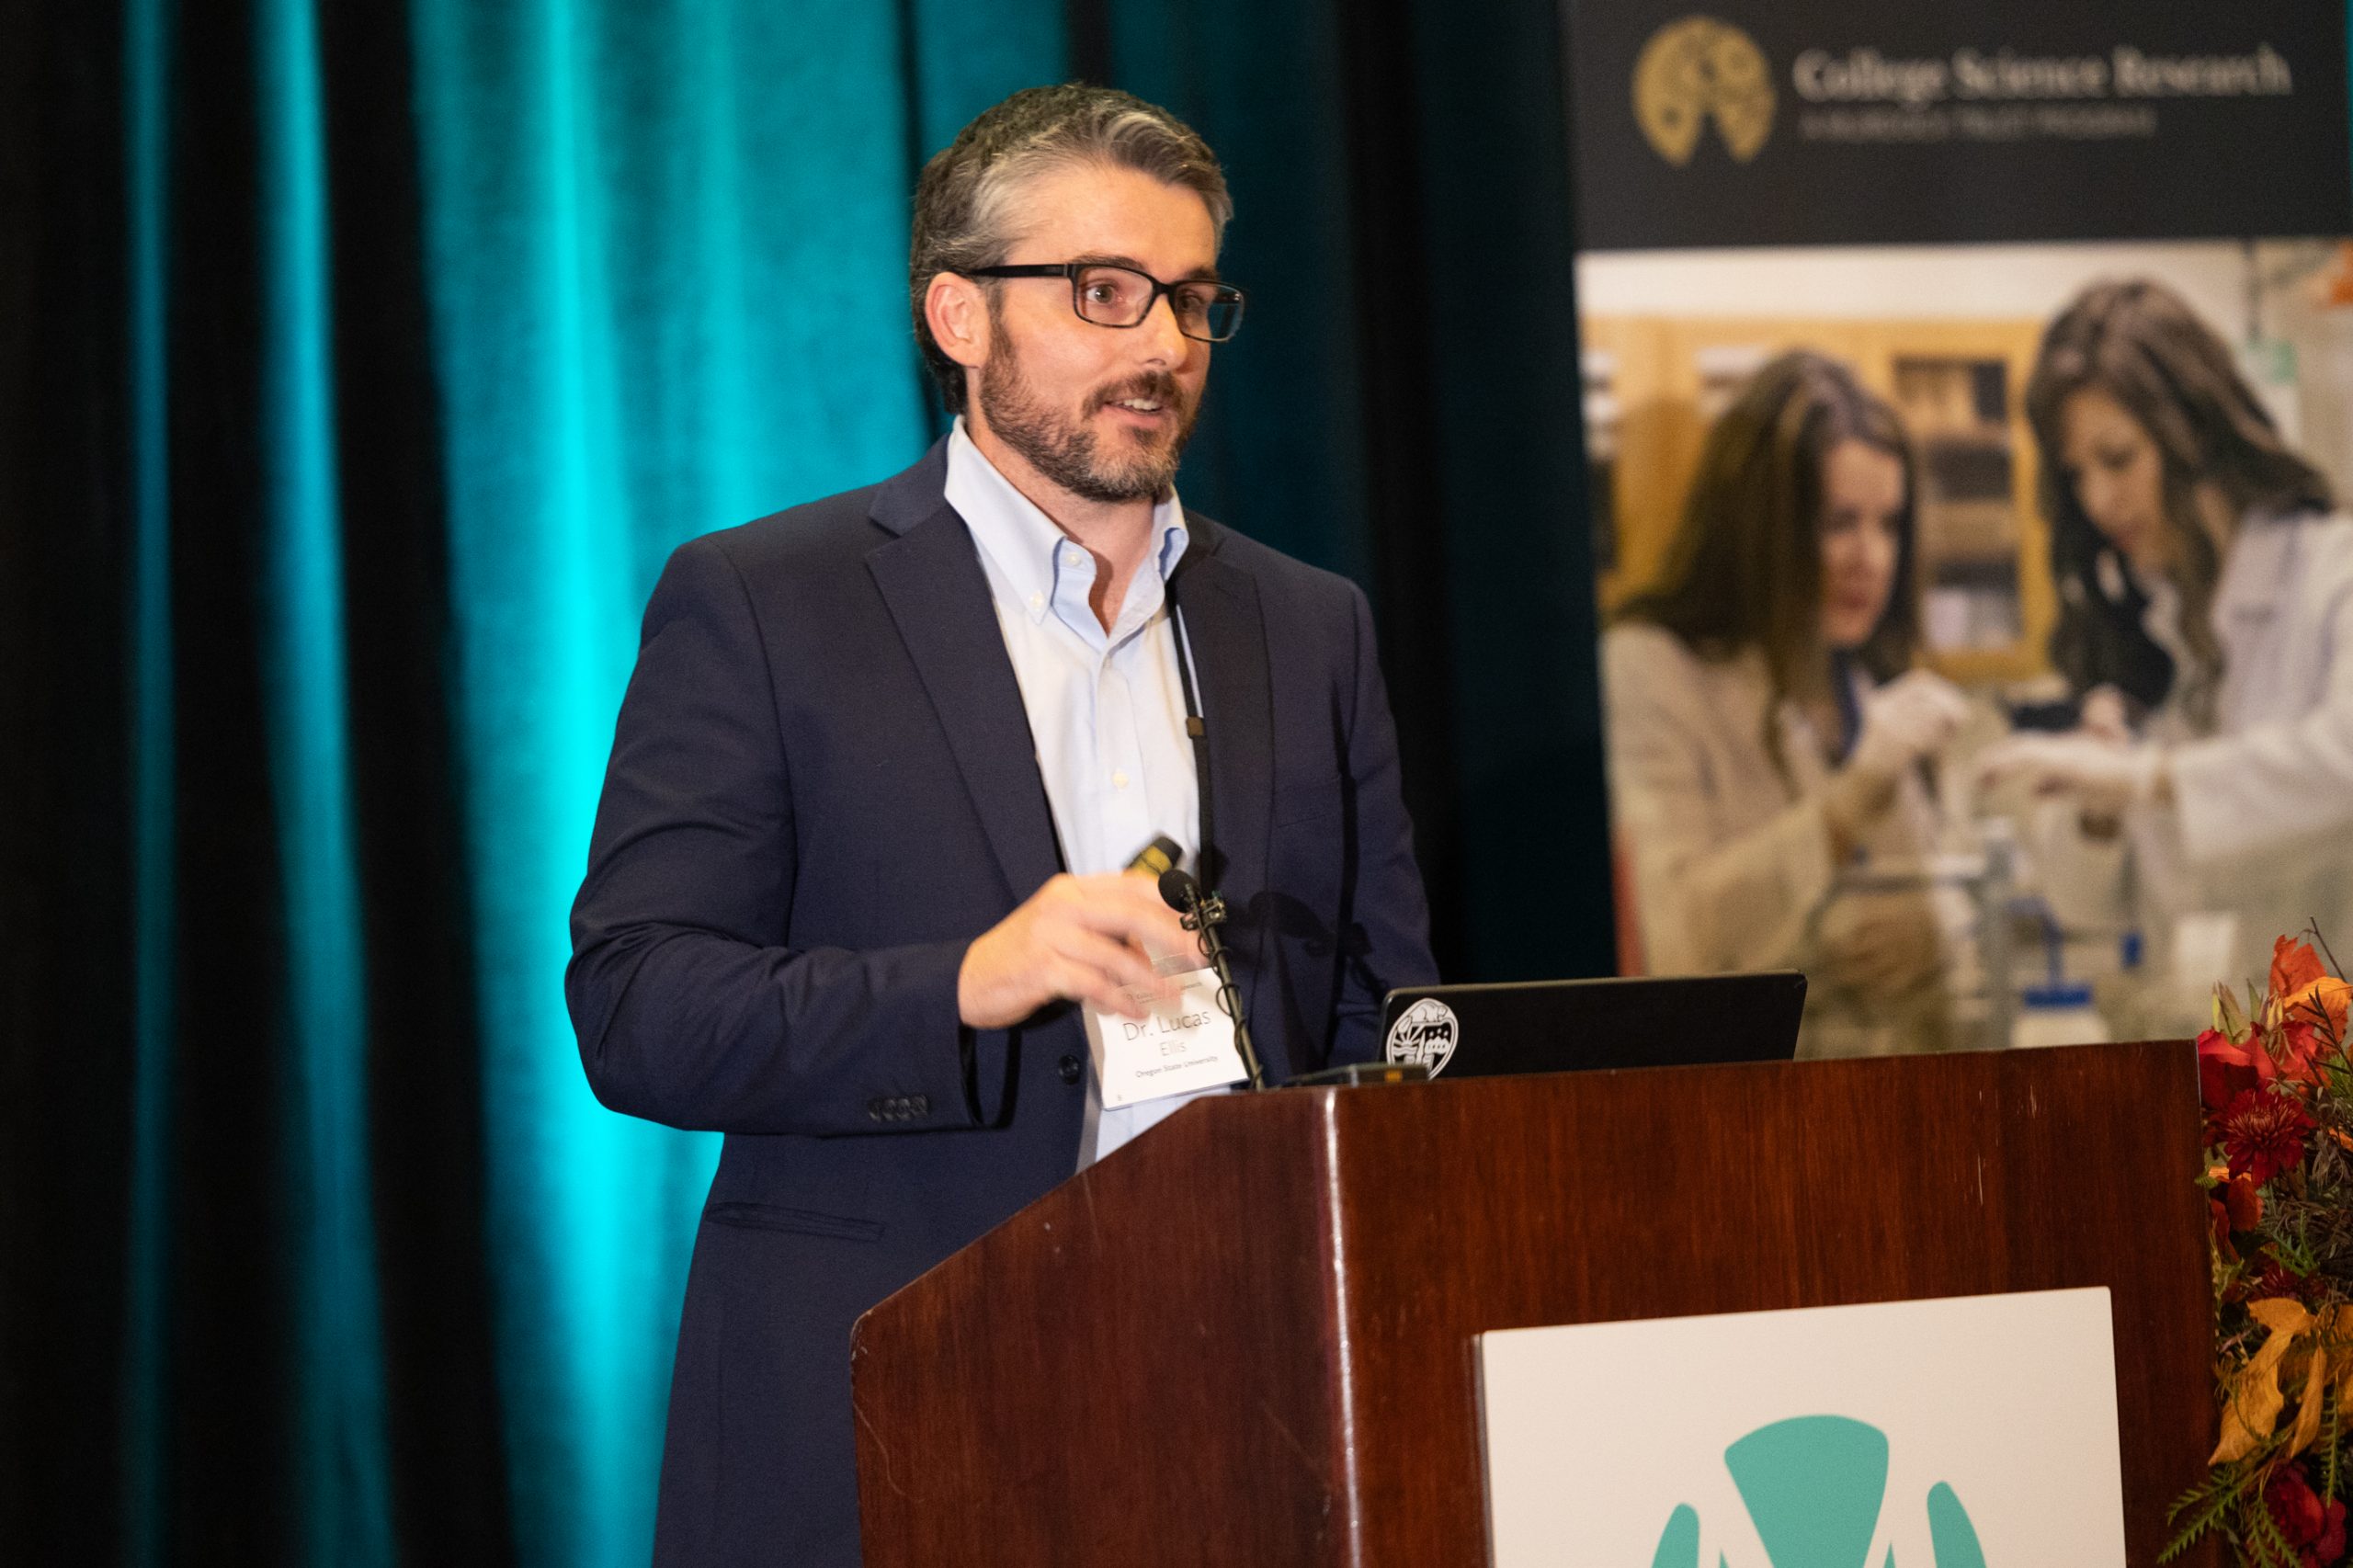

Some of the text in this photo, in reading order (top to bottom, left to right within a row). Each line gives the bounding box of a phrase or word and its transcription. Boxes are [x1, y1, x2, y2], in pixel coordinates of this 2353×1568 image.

[1792, 42, 2292, 112] College Science Research
[1122, 1011, 1211, 1040] Dr. Lucas
[1160, 1040, 1186, 1056] Ellis
[1135, 1056, 1218, 1078] Oregon State University
